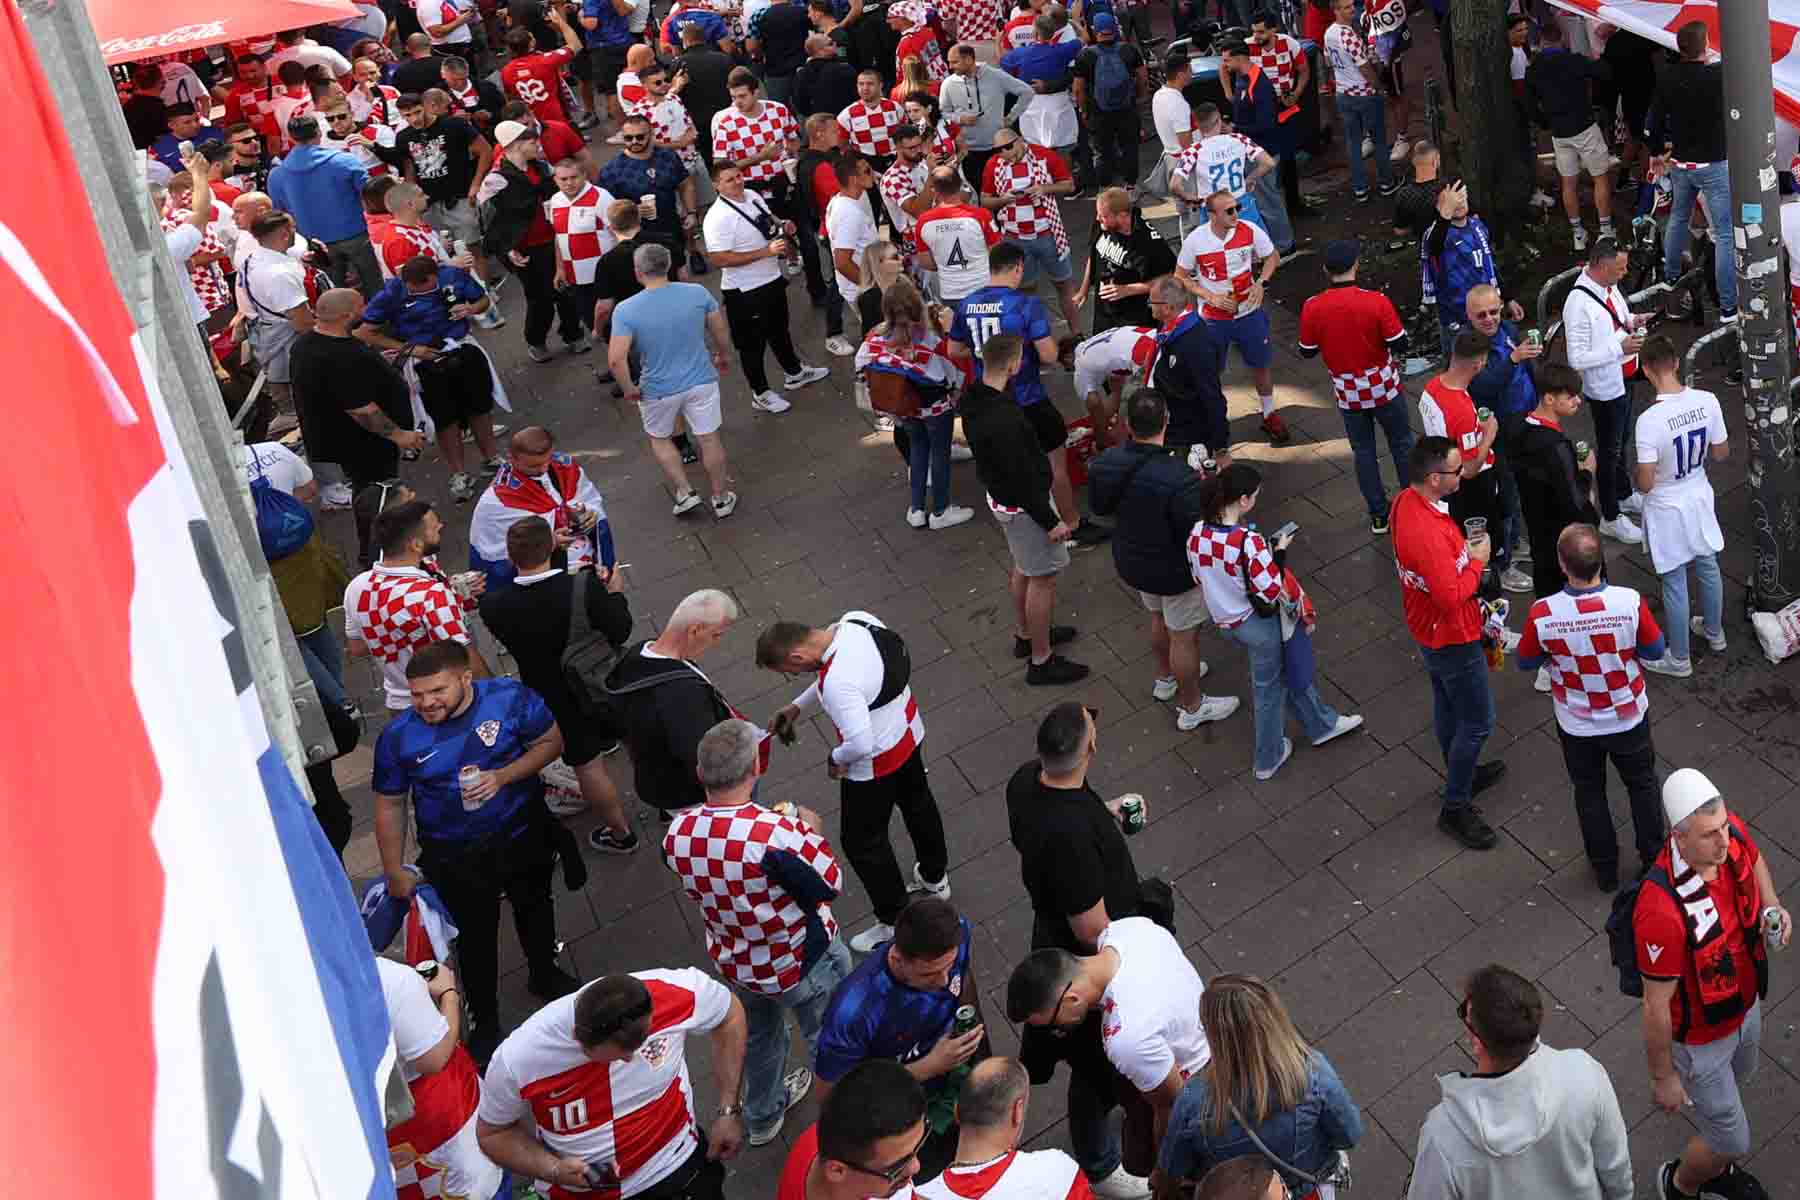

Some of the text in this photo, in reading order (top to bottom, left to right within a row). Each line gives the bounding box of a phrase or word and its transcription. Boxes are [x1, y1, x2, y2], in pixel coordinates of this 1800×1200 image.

[947, 236, 969, 271] 4
[1672, 426, 1708, 480] 10
[548, 1097, 589, 1132] 10
